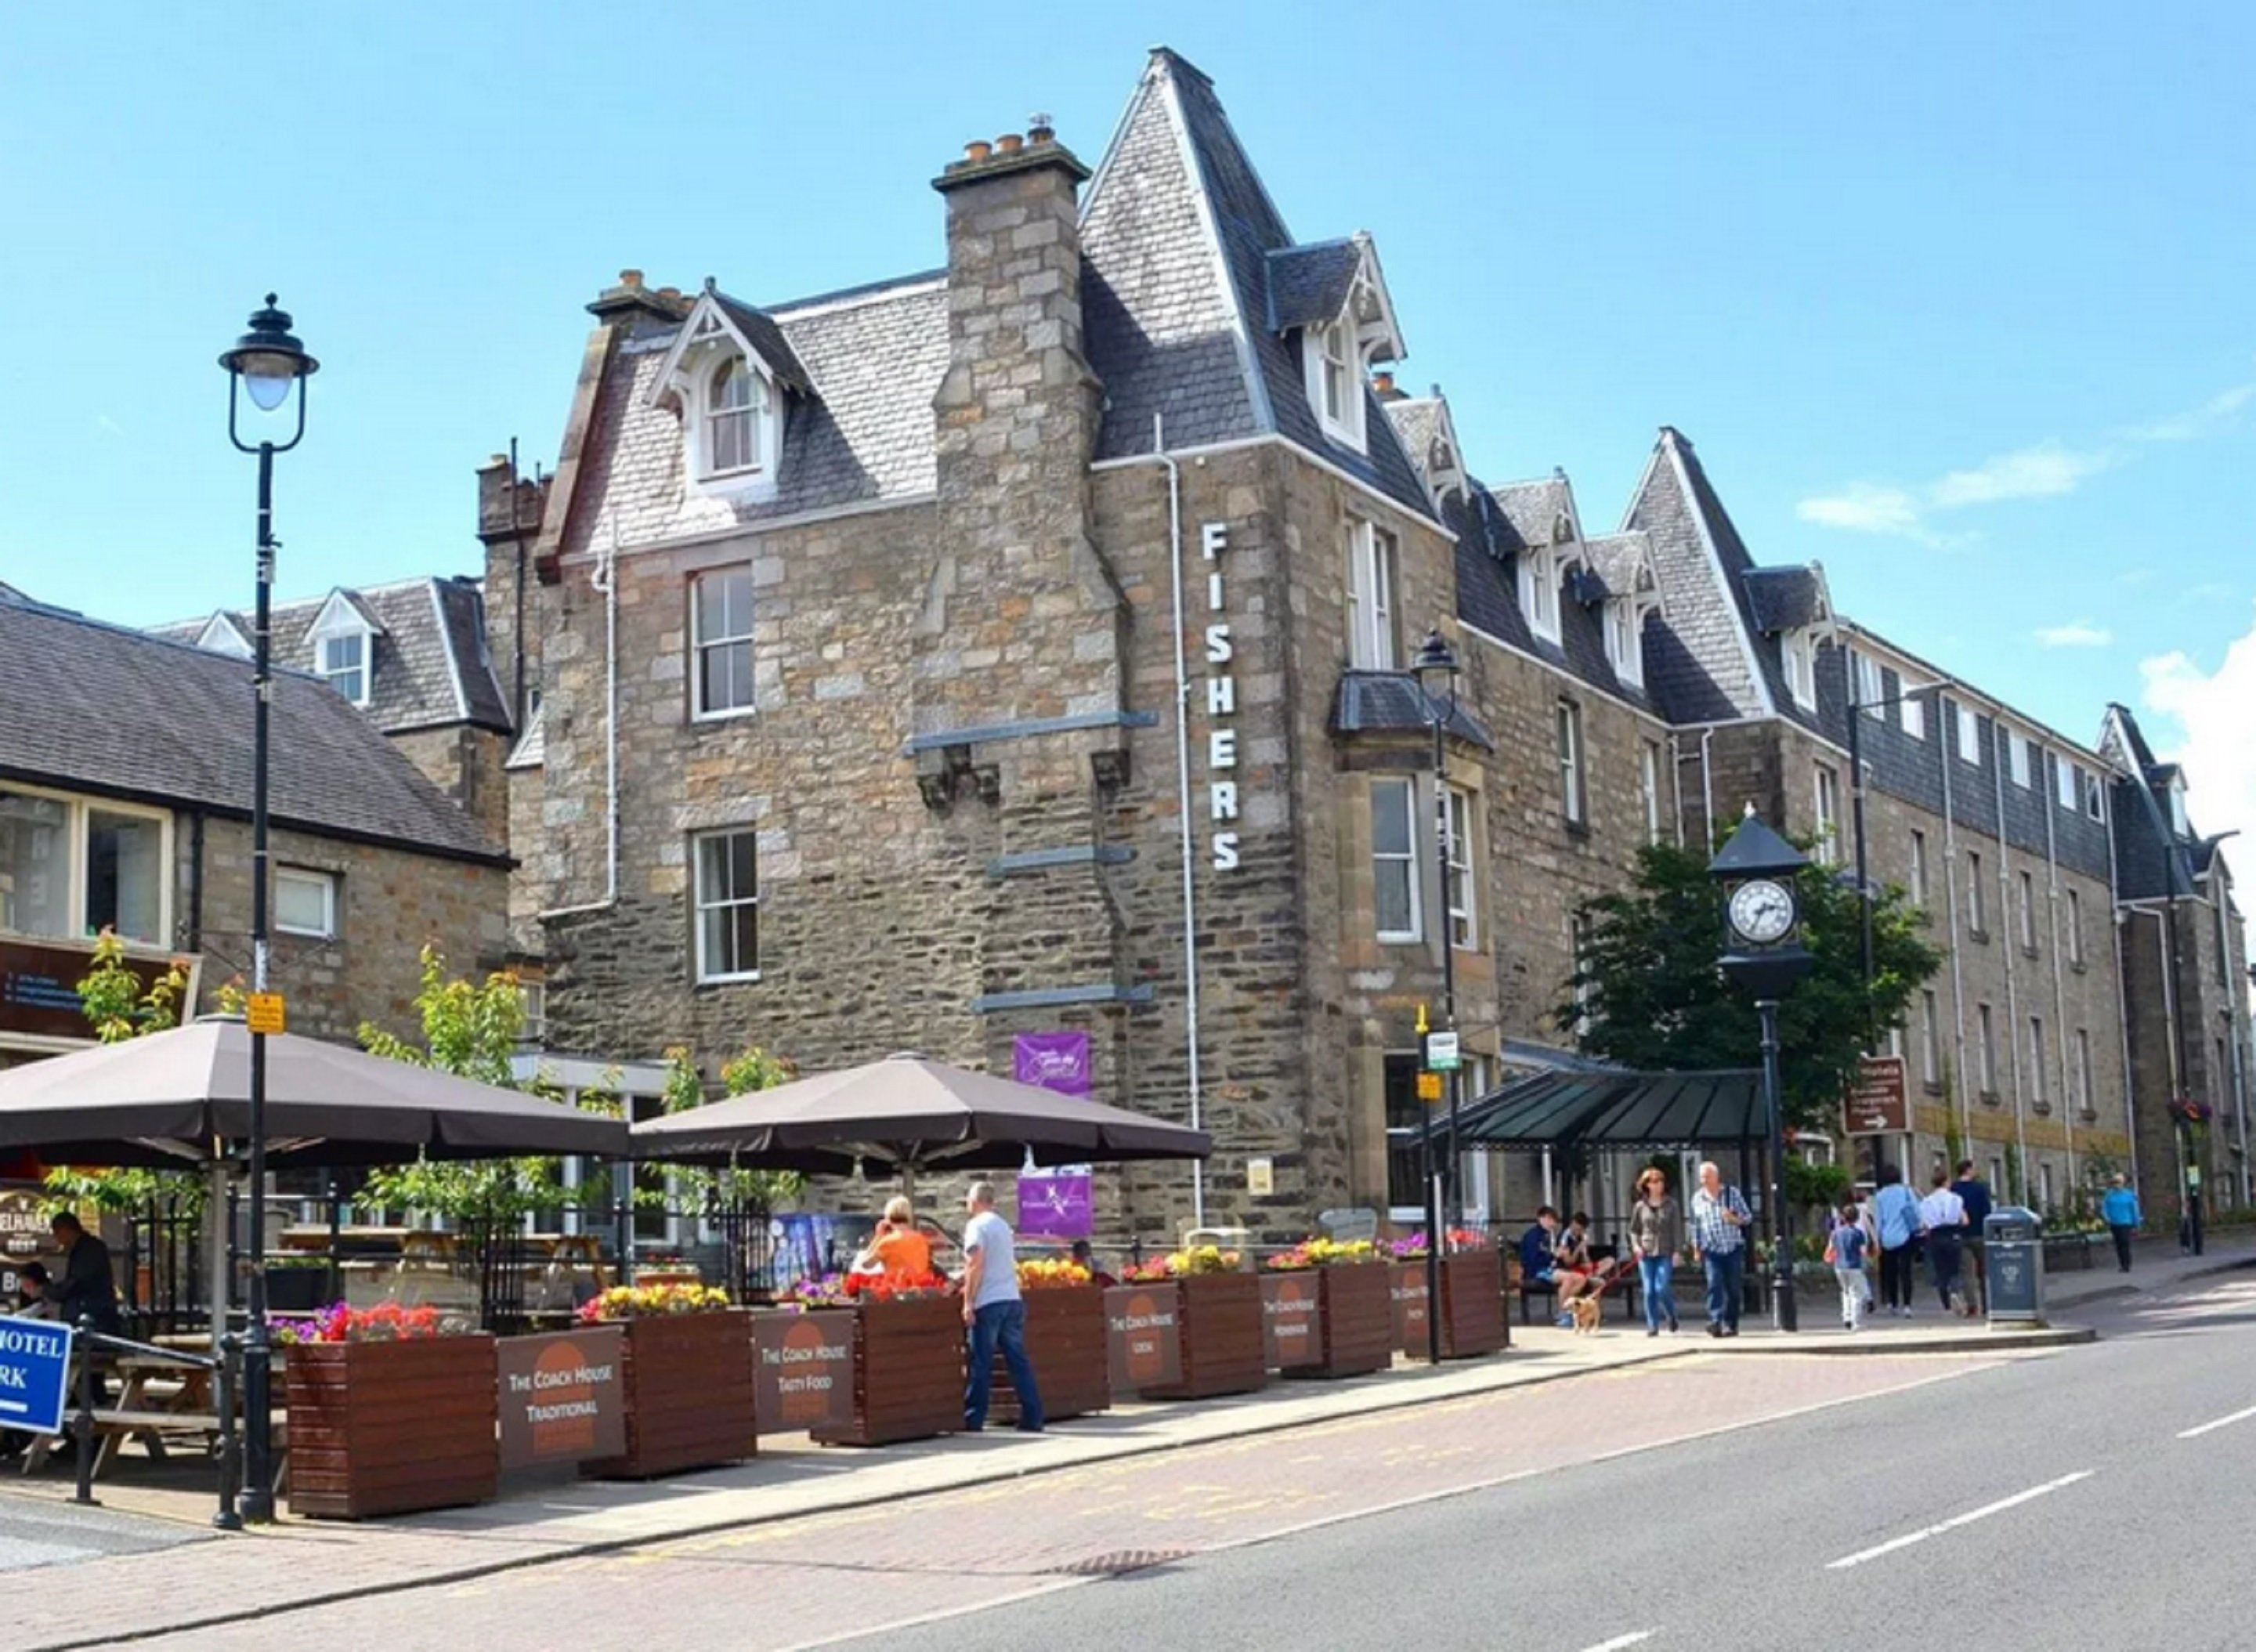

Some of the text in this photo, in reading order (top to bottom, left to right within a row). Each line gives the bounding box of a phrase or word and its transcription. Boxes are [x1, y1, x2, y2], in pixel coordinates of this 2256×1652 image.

[1202, 522, 1239, 871] FISHERS
[762, 1345, 846, 1364] THE COACH HOUSE
[509, 1365, 613, 1392] THE COACH HOUSE
[806, 1375, 833, 1391] FOOD
[526, 1400, 598, 1423] TRADITIONAL
